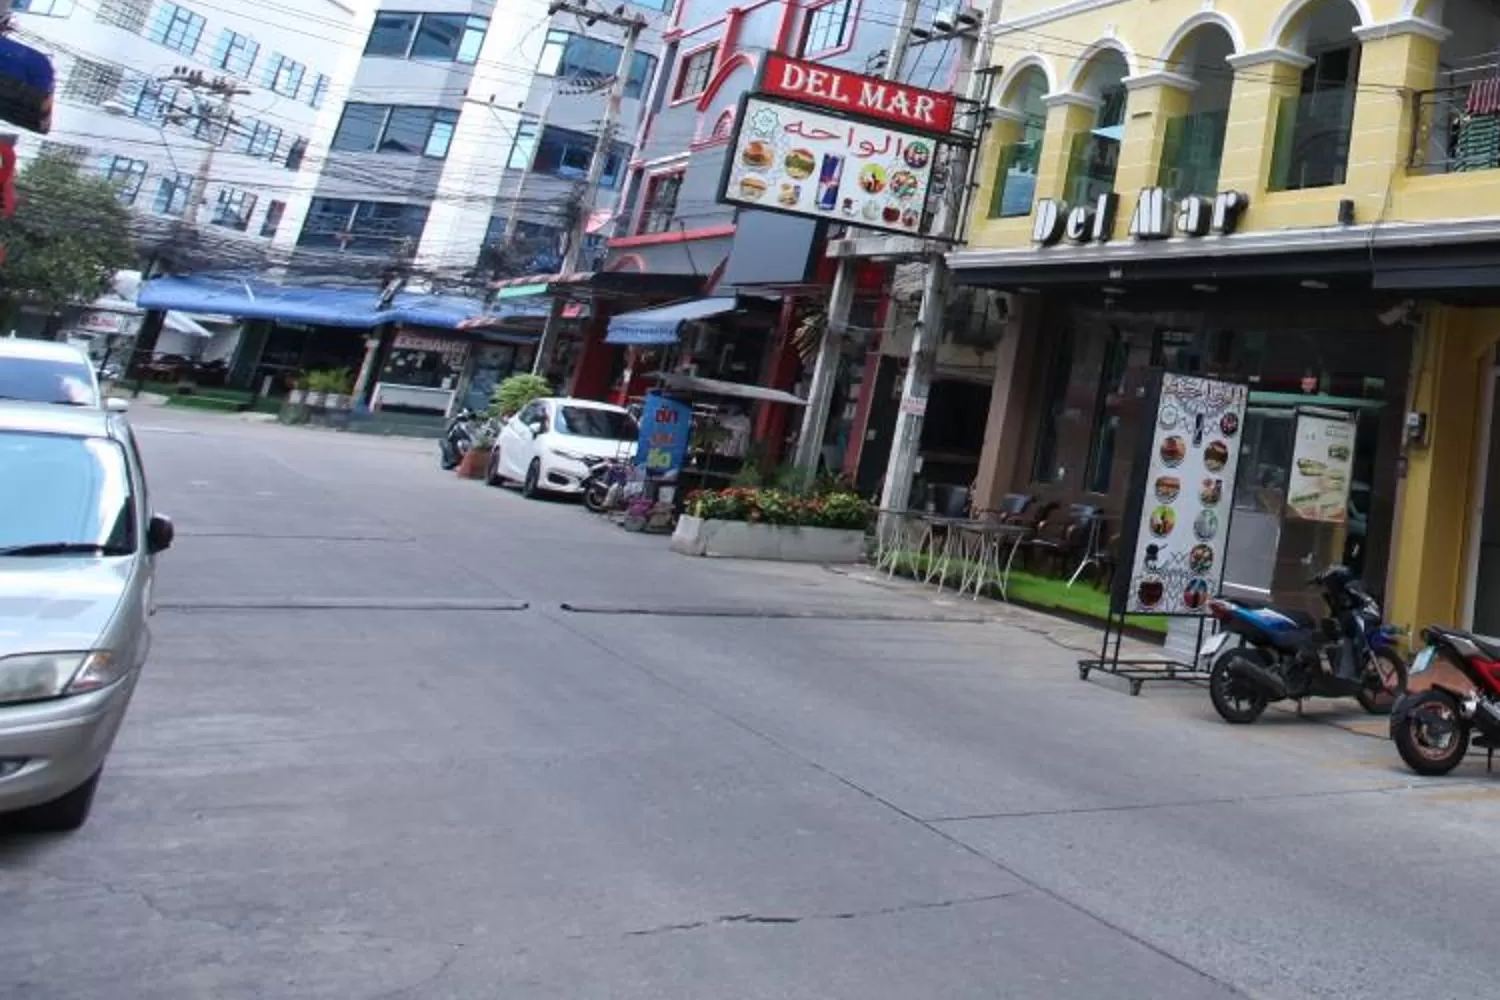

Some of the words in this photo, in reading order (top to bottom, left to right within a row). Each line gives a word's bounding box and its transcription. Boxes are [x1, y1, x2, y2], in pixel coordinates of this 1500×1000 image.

[779, 63, 849, 106] DEL
[858, 81, 936, 124] MAR
[1032, 192, 1113, 243] Del
[1128, 187, 1242, 236] Mar
